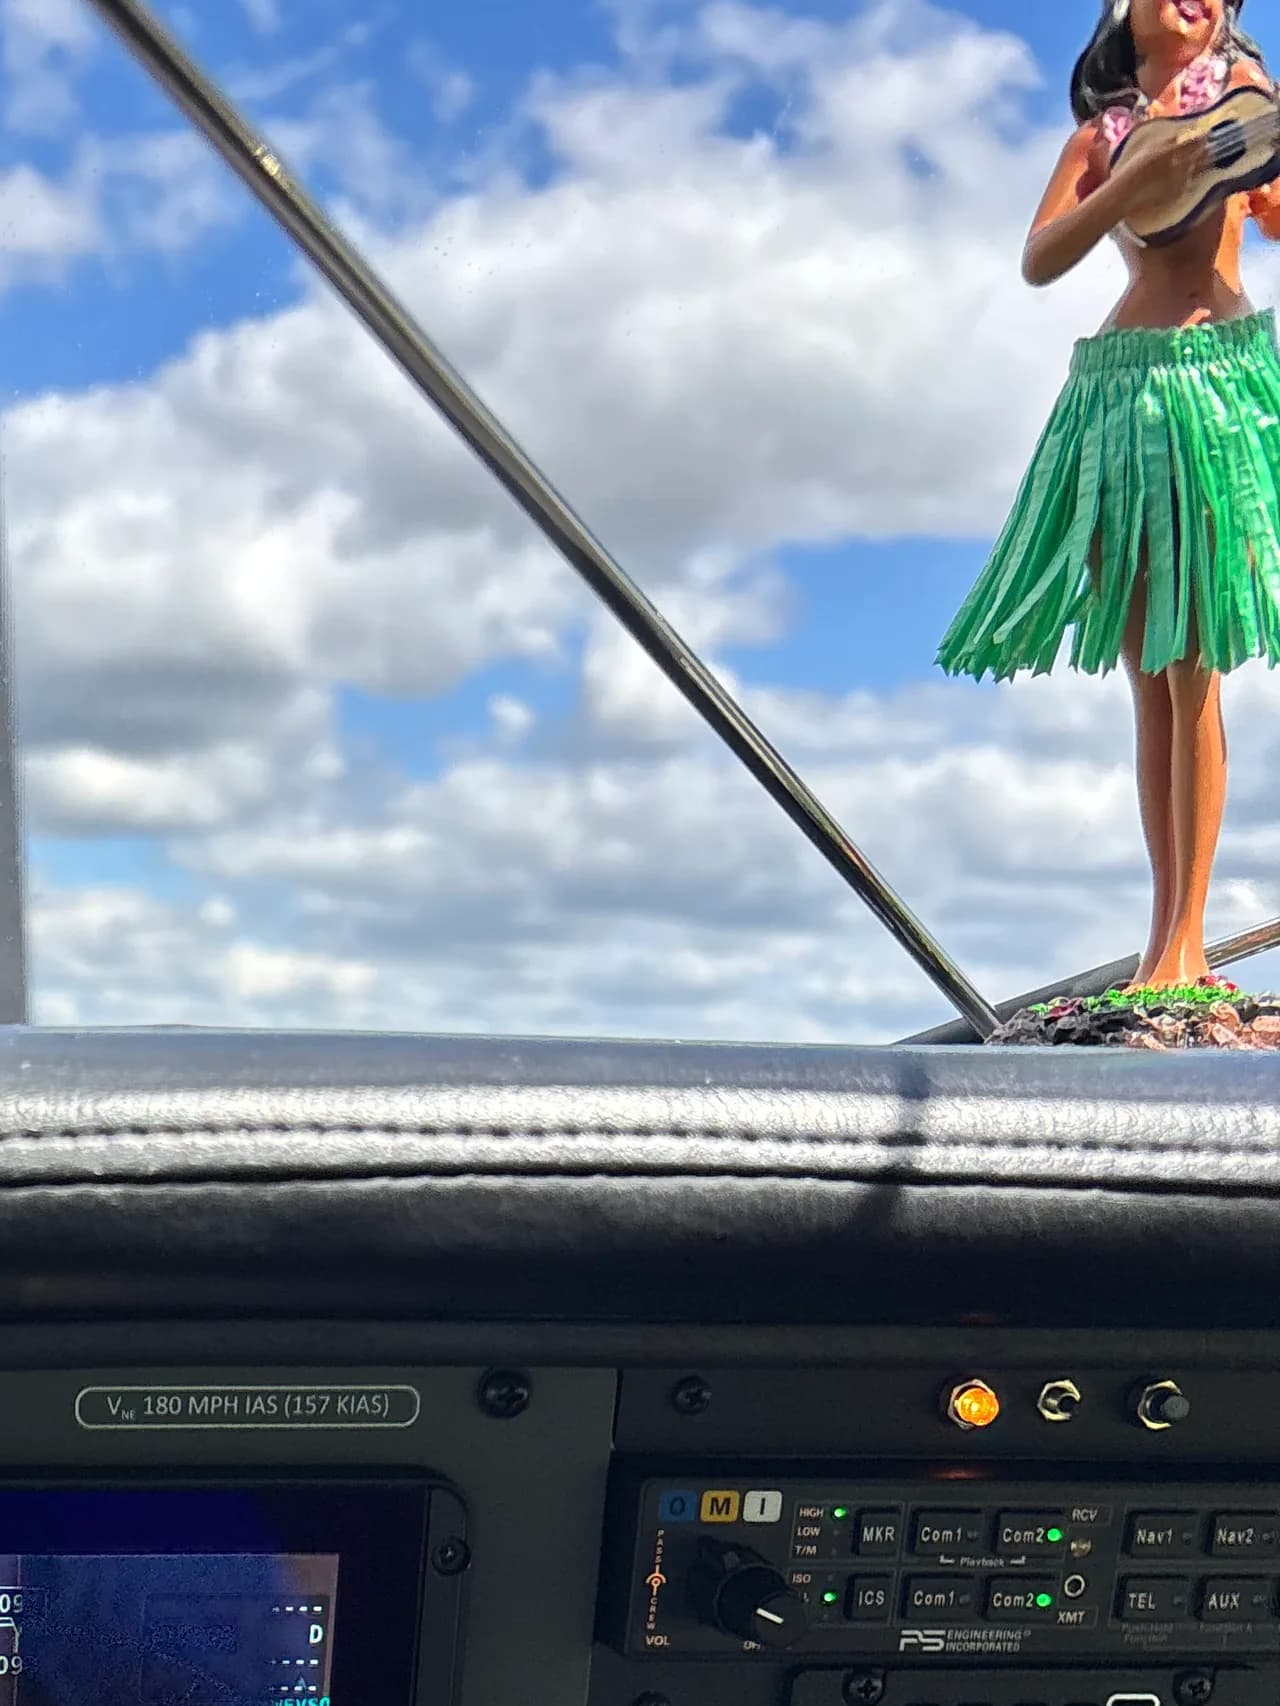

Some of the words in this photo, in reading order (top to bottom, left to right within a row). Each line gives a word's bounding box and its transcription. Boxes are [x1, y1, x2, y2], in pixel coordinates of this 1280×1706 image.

[143, 1395, 181, 1416] 180
[189, 1395, 239, 1415] MPH
[246, 1395, 278, 1415] IAS
[284, 1394, 330, 1418] (157
[337, 1394, 390, 1418] KIAS)
[709, 1498, 730, 1515] M
[863, 1526, 895, 1542] MKR
[921, 1526, 962, 1543] Com1
[1002, 1528, 1044, 1543] Com2
[1136, 1529, 1173, 1545] Nav1
[1216, 1529, 1254, 1545] Nav2
[858, 1590, 885, 1606] ICS
[914, 1590, 955, 1606] Com1
[993, 1592, 1034, 1607] Com2
[1128, 1592, 1156, 1610] TEL
[1208, 1592, 1240, 1609] AUX
